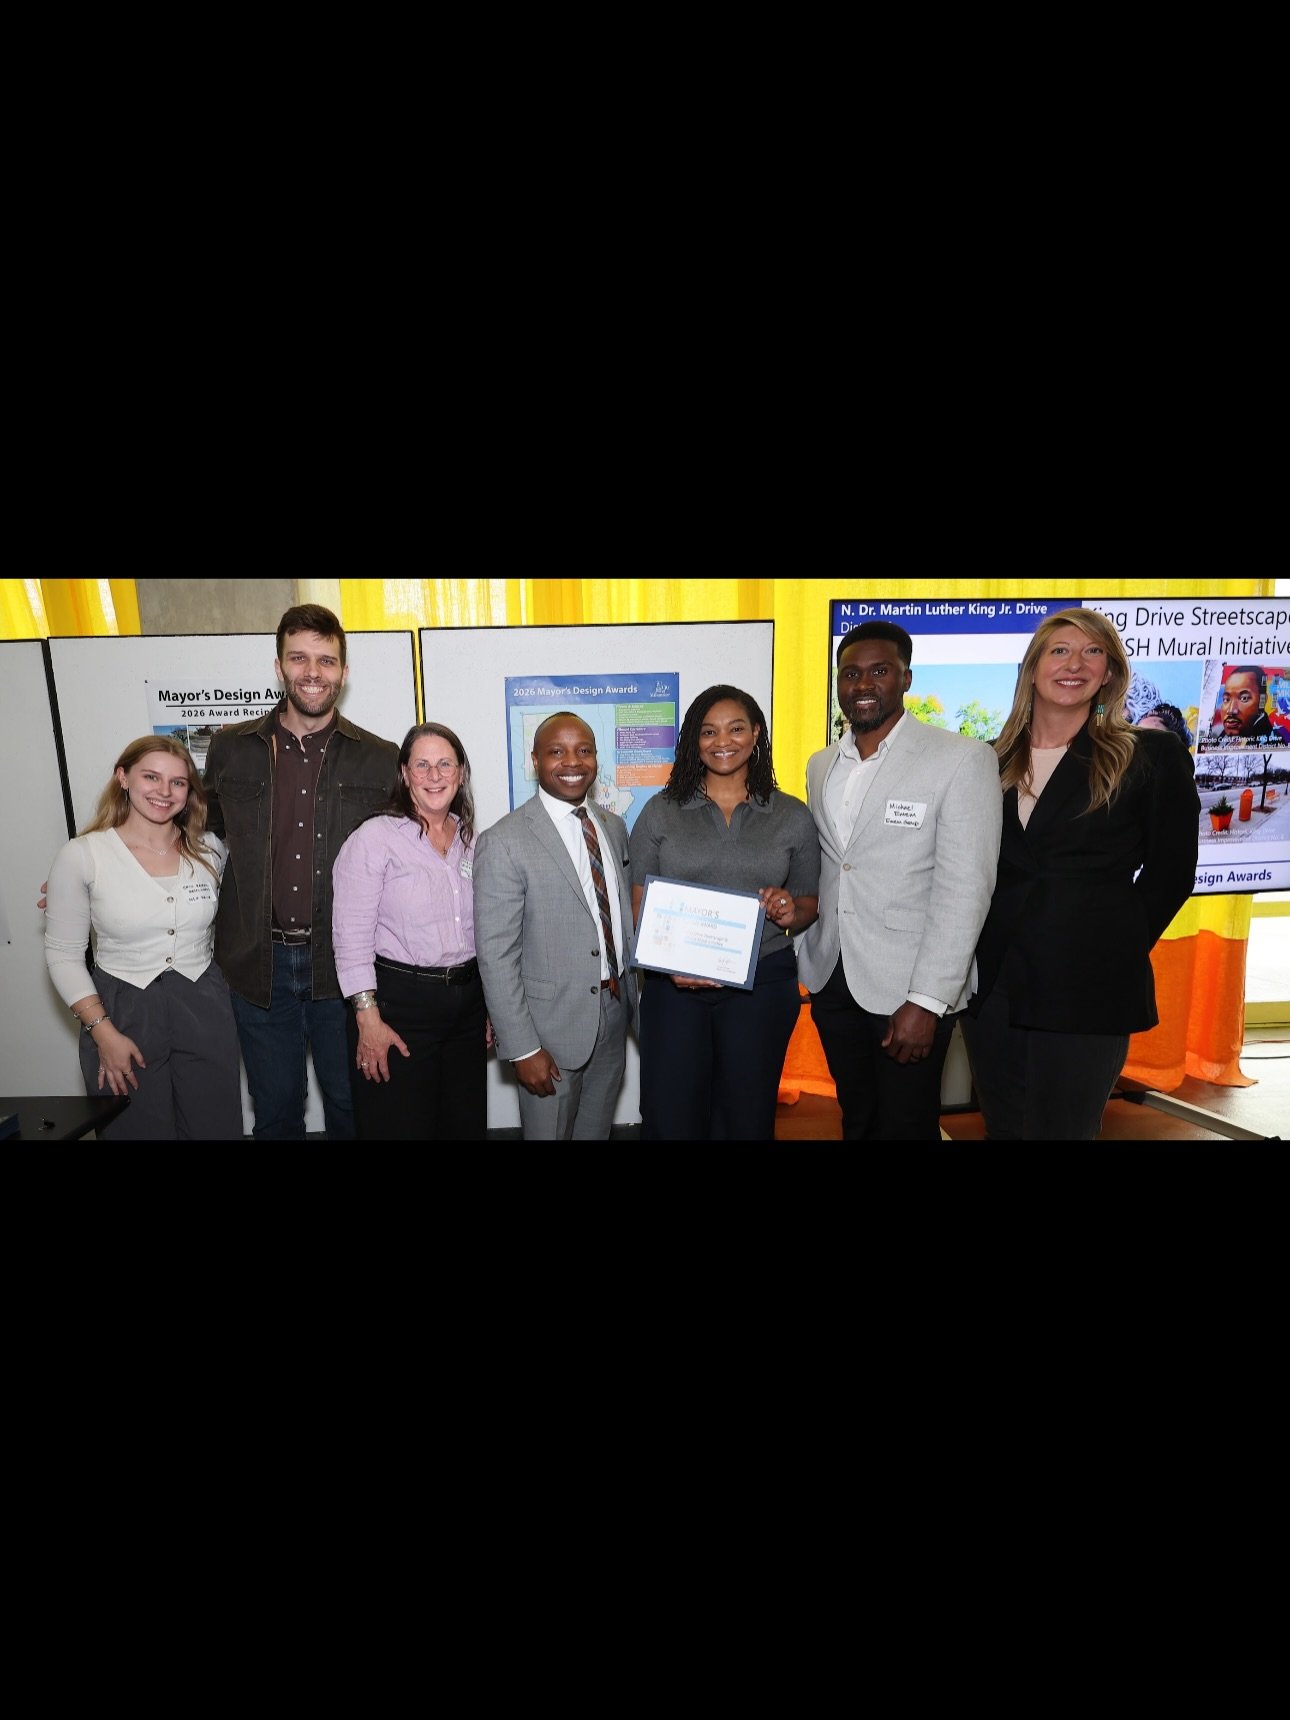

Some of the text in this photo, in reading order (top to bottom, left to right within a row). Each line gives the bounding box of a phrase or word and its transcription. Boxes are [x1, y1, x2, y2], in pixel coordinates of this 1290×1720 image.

[841, 603, 1048, 618] N. Dr. Martin Luther King Jr. Drive
[1093, 606, 1290, 632] ng Drive Streetscap
[1121, 638, 1150, 656] SH
[1158, 636, 1212, 656] Mural
[158, 688, 288, 704] Mayor's Design Aw
[514, 685, 638, 697] 2026 Mayor's Design Awards
[181, 710, 205, 718] 2026
[208, 708, 240, 717] Award
[1227, 869, 1272, 882] Awards
